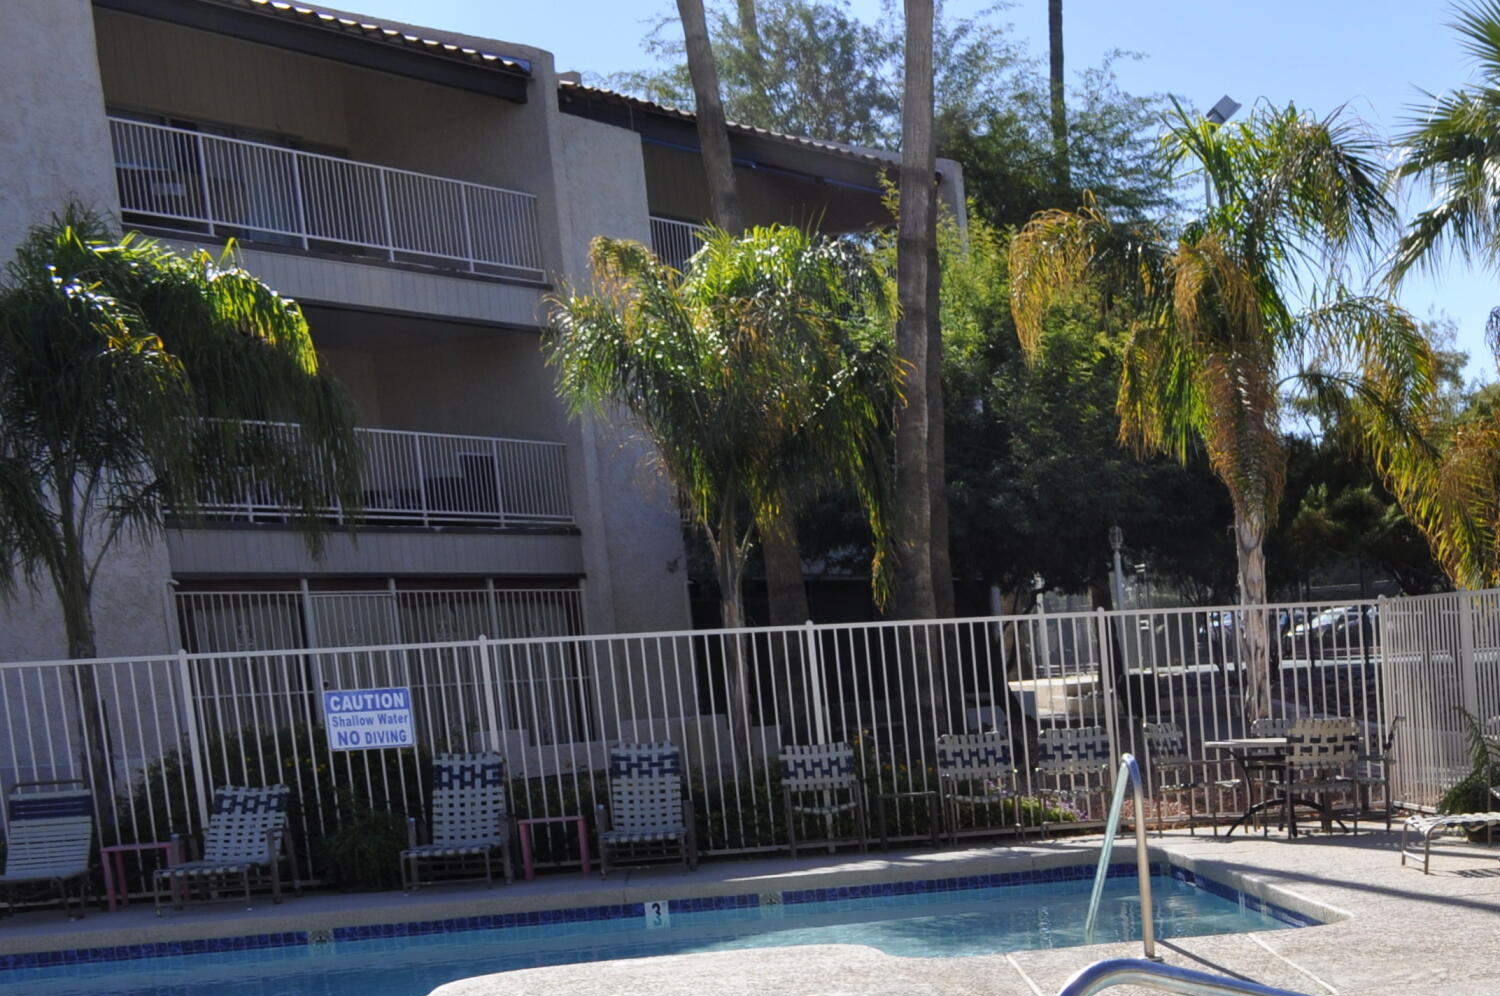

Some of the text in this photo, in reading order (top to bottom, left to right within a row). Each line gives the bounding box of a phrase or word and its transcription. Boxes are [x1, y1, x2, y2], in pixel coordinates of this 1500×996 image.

[330, 692, 404, 711] CAUTION
[332, 713, 408, 727] Shallow Water
[337, 729, 407, 746] NO DIVING
